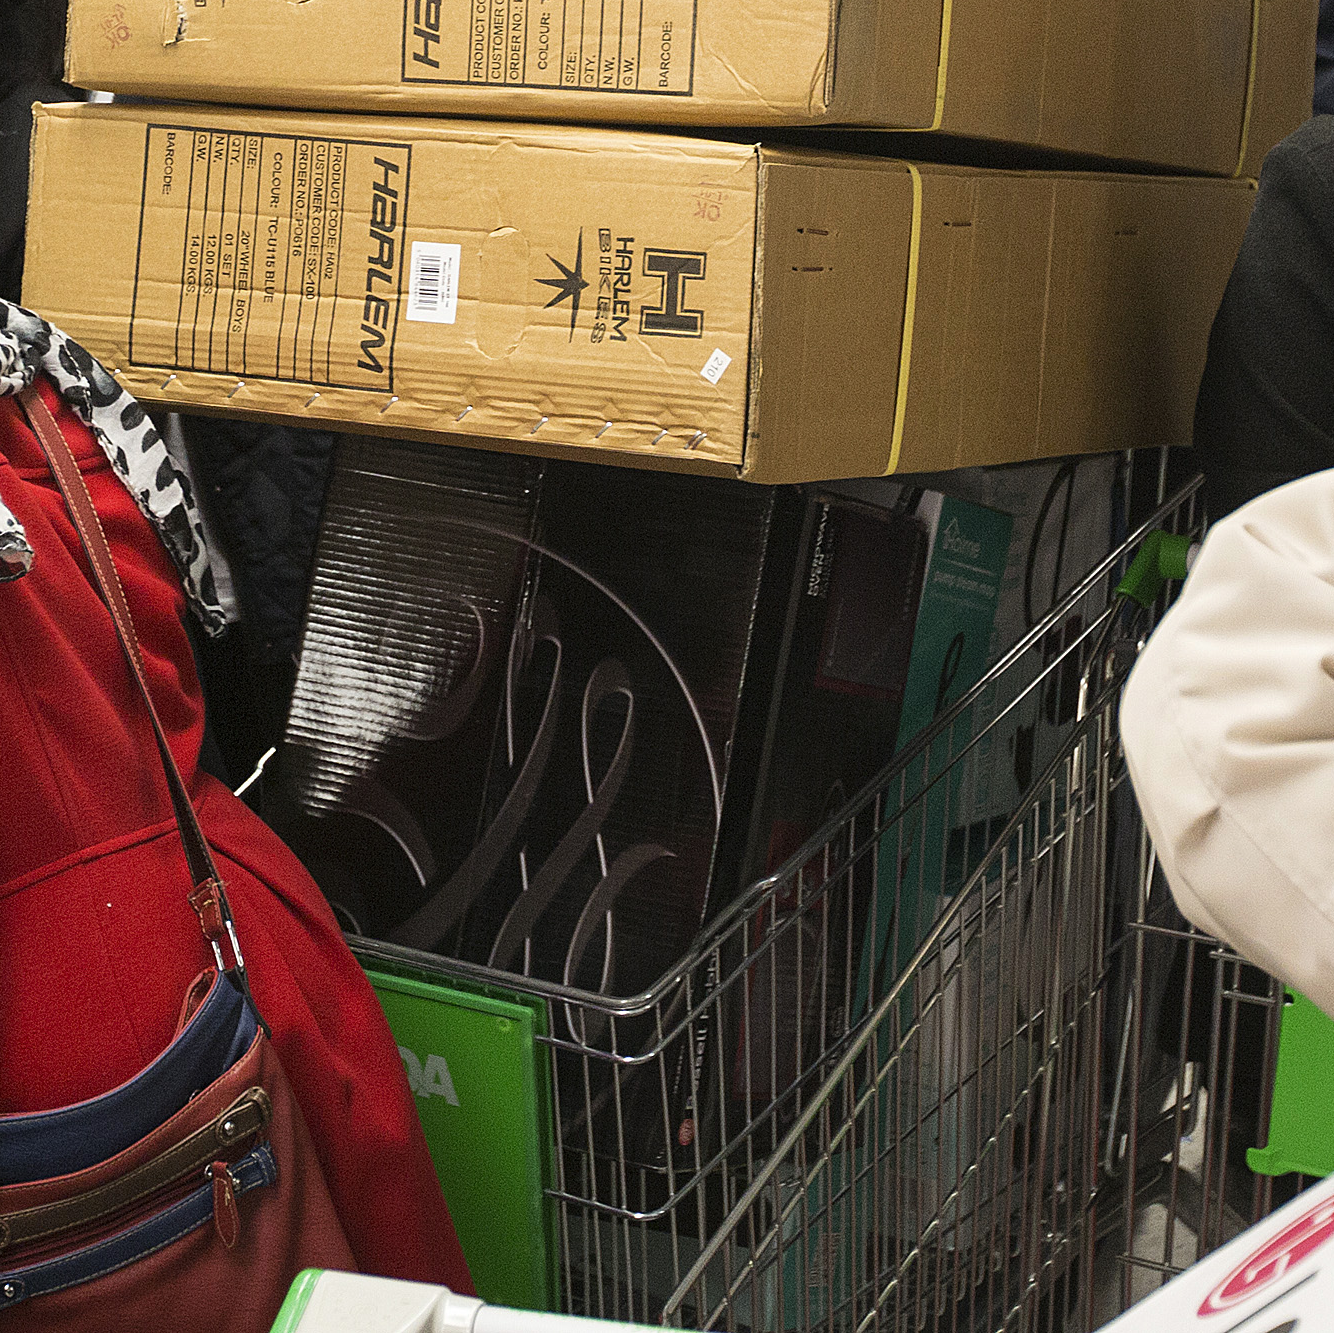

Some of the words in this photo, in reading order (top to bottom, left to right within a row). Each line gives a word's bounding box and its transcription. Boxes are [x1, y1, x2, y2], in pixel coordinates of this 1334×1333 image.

[473, 18, 486, 78] PRODUCT
[490, 8, 504, 80] CUSTOMER
[509, 34, 521, 81] ORDER
[538, 12, 551, 70] COLOUR:
[658, 21, 673, 88] BARCODE:
[566, 52, 577, 83] SIZE:
[584, 55, 596, 83] QTY.
[603, 57, 615, 85] N.W.
[623, 57, 635, 86] G.W.
[162, 132, 176, 195] BARCODE:
[196, 134, 207, 163] G.W.
[213, 135, 225, 163] N.W.
[230, 137, 242, 165] QTY.
[246, 138, 258, 169] SIZE:
[270, 152, 283, 208] COLOUR:
[297, 143, 309, 189] ORDER
[312, 144, 326, 215] CUSTOMER
[328, 146, 343, 202] PRODUCT
[224, 233, 234, 247] 01
[265, 216, 279, 269] TC-U115
[309, 216, 322, 258] CODE:
[326, 203, 339, 249] CODE:
[188, 234, 200, 266] 14.00
[205, 234, 217, 266] 12.00
[221, 253, 232, 278] SET
[323, 250, 335, 280] HA02
[185, 267, 197, 296] KGS.
[202, 268, 214, 297] KGS.
[263, 272, 276, 304] BLUE
[305, 259, 318, 300] SX-100
[591, 229, 612, 343] BIKES
[610, 237, 634, 342] HARLEM
[638, 248, 707, 339] H
[231, 299, 246, 333] BOYS
[706, 355, 724, 379] 210
